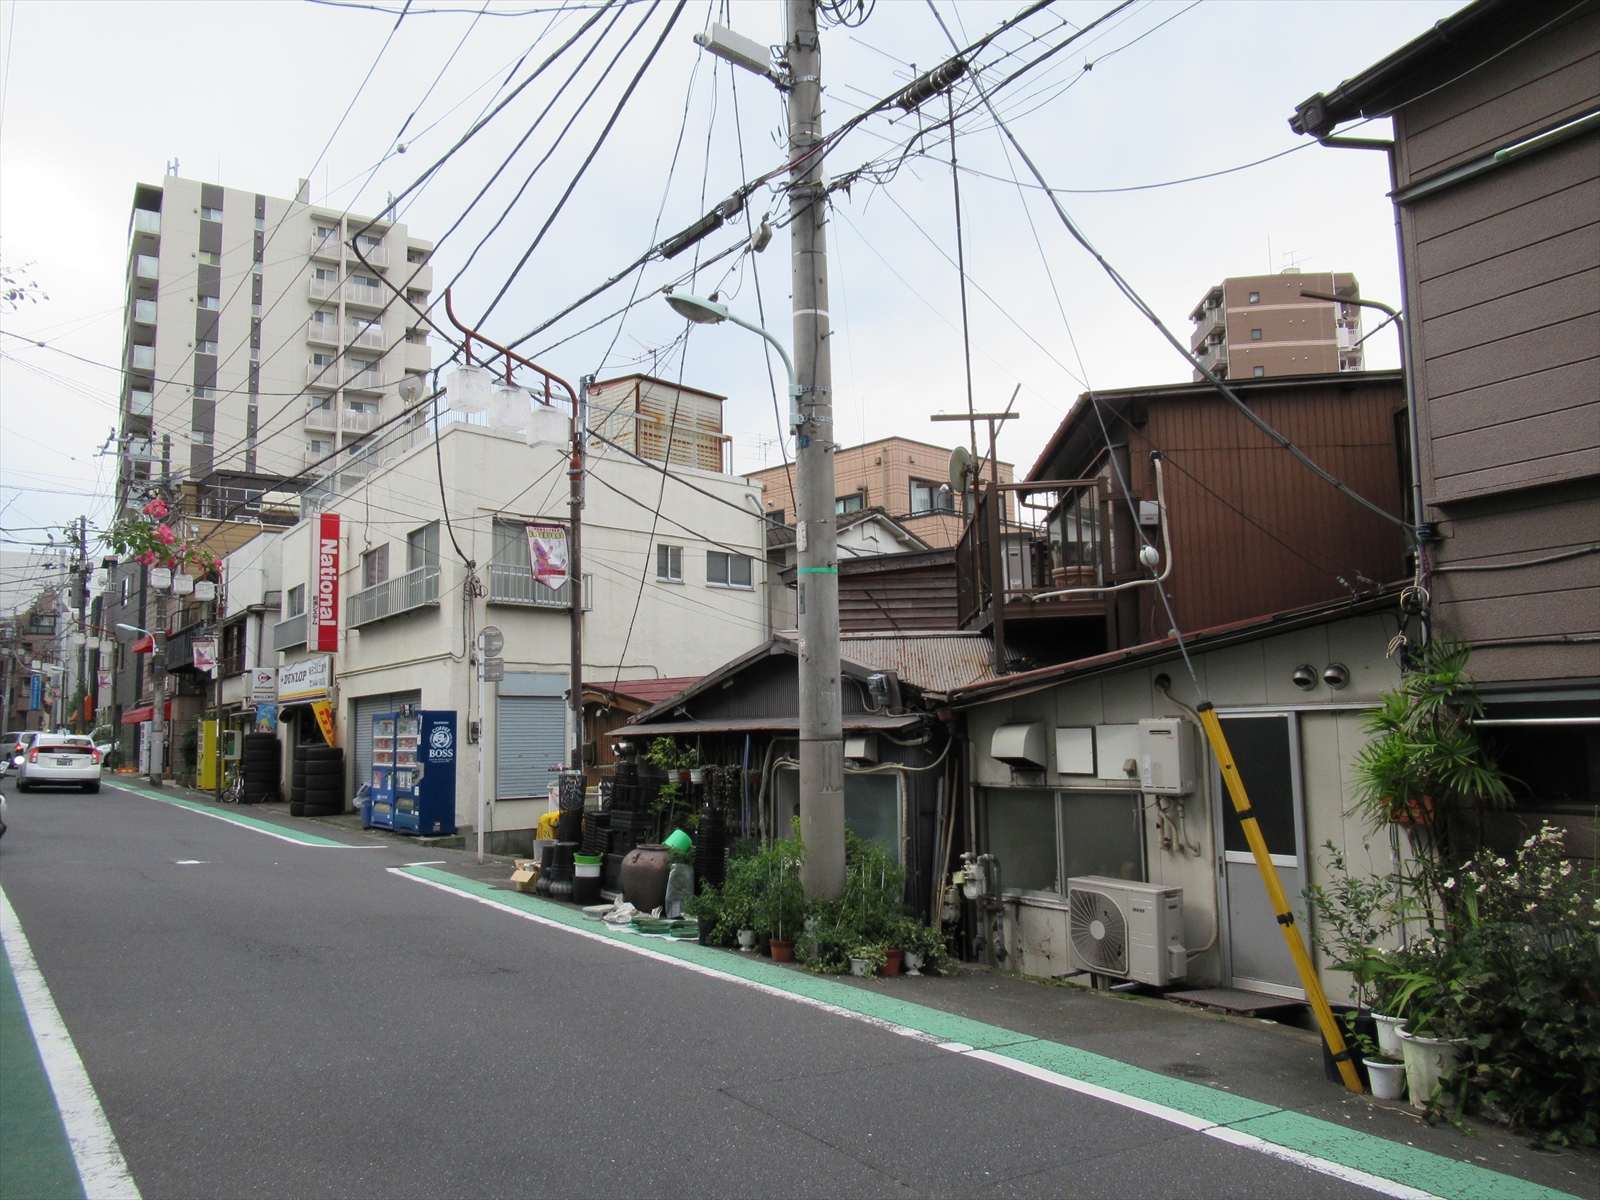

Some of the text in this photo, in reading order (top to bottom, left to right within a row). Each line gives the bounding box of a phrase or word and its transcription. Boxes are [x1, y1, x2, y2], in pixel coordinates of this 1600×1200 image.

[320, 539, 338, 626] National
[283, 670, 307, 685] DUNLOP
[432, 725, 450, 734] COFFEE
[429, 748, 453, 758] BOSS
